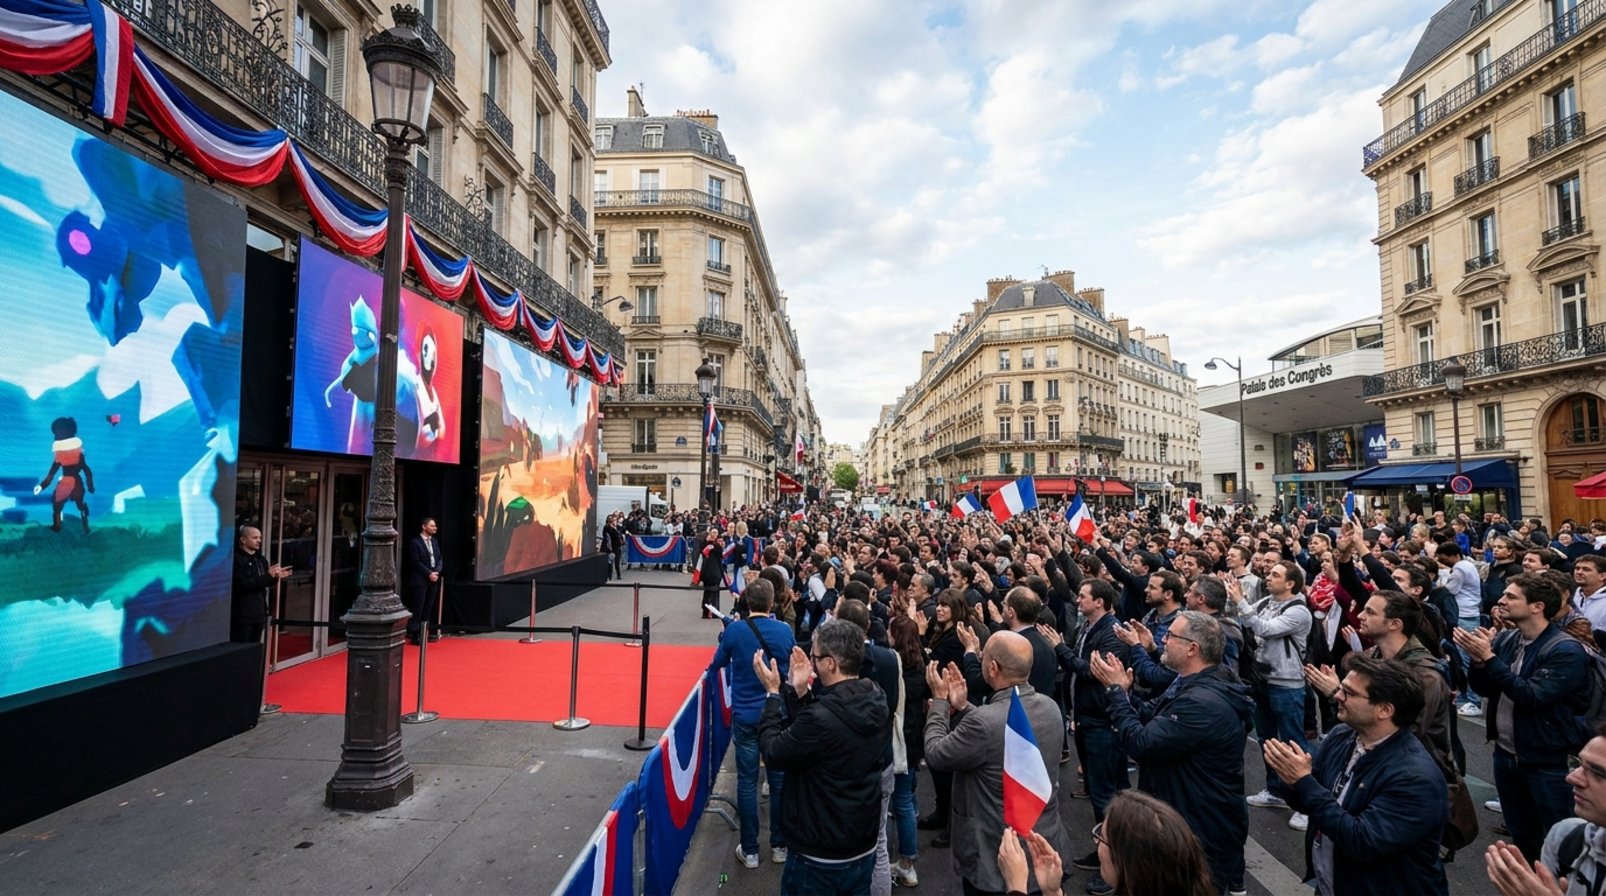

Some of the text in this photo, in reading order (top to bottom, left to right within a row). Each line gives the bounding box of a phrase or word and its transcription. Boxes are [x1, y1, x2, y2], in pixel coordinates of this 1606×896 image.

[1242, 363, 1333, 395] Palais des Congrès
